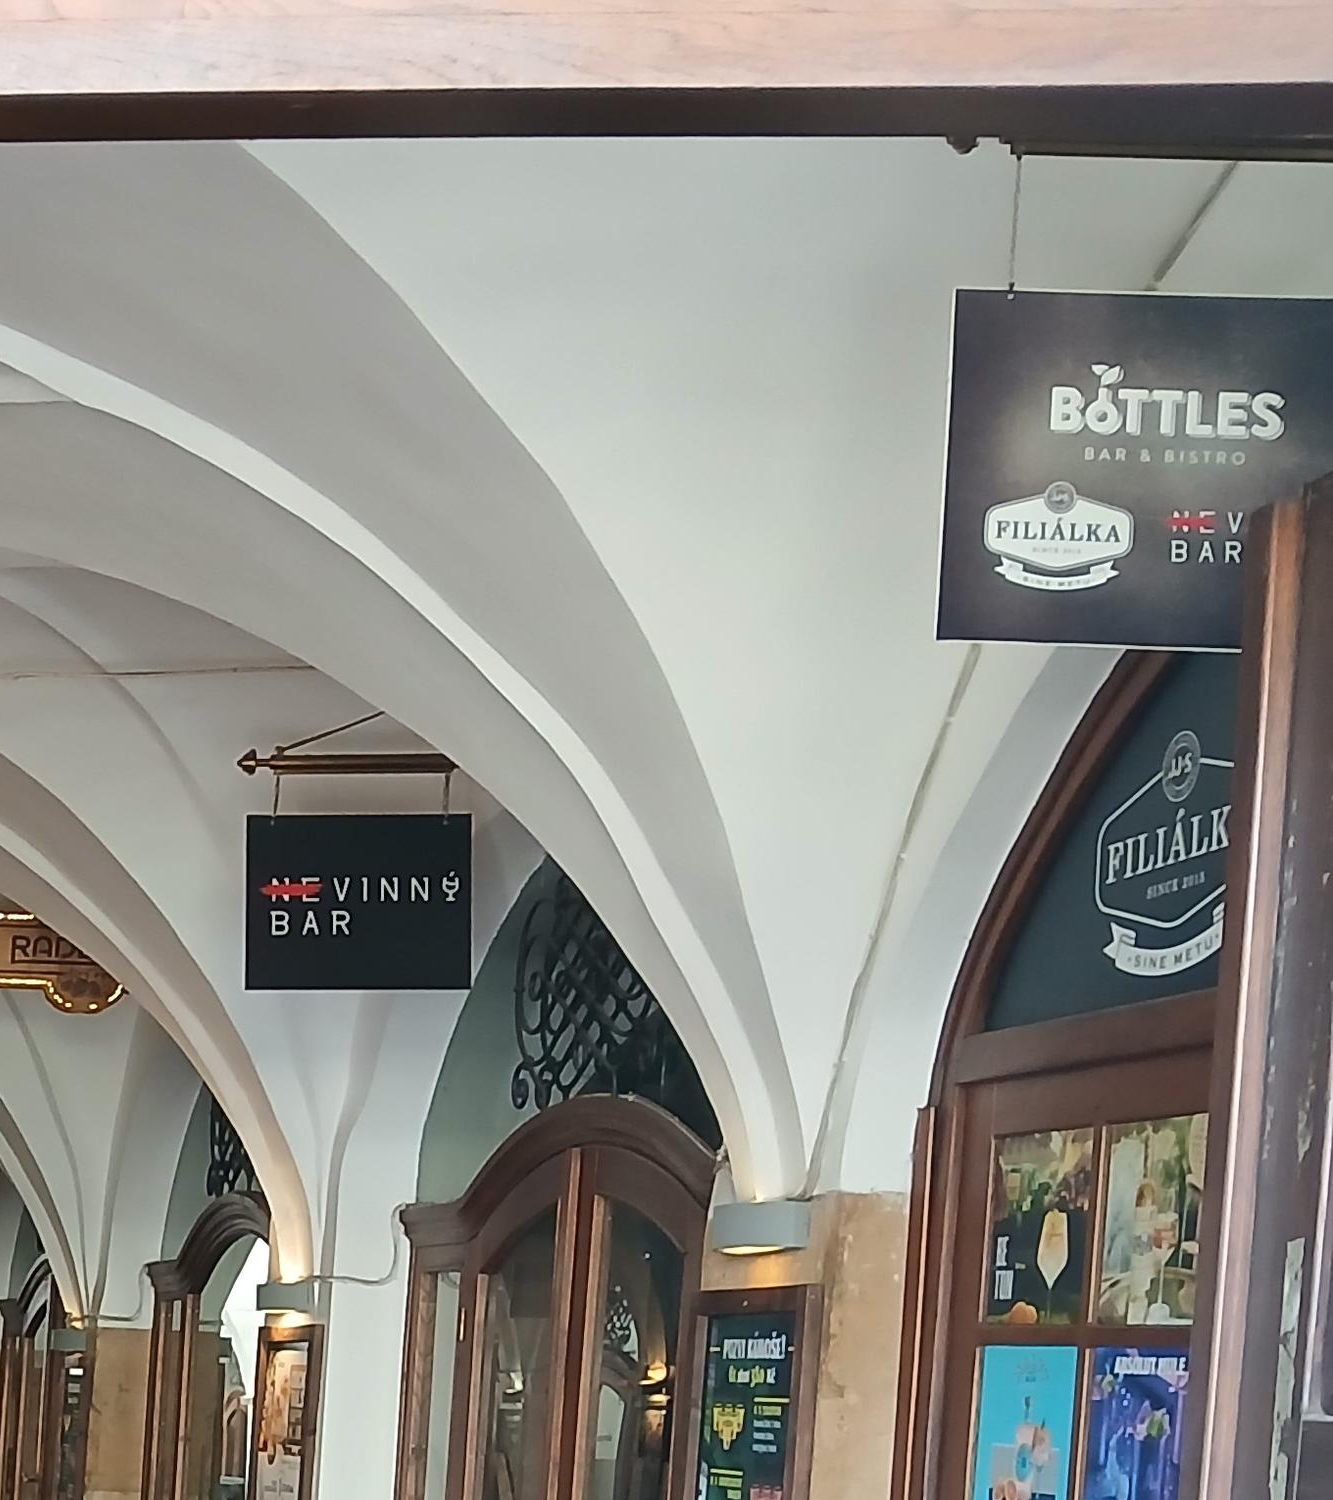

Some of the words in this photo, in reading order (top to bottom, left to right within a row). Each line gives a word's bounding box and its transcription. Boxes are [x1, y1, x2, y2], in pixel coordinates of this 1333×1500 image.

[1049, 385, 1286, 440] BOTTLES
[1084, 446, 1127, 462] BAR
[1139, 448, 1152, 462] &
[1164, 448, 1247, 466] BISTRO
[995, 516, 1122, 543] FILIÁLKA
[1171, 510, 1245, 535] NEV
[1170, 540, 1243, 564] BAR
[1105, 804, 1232, 885] FILIÁLK
[269, 910, 352, 936] BAR
[10, 934, 89, 960] RAD
[1134, 952, 1167, 970] SINE
[1173, 937, 1213, 964] METU
